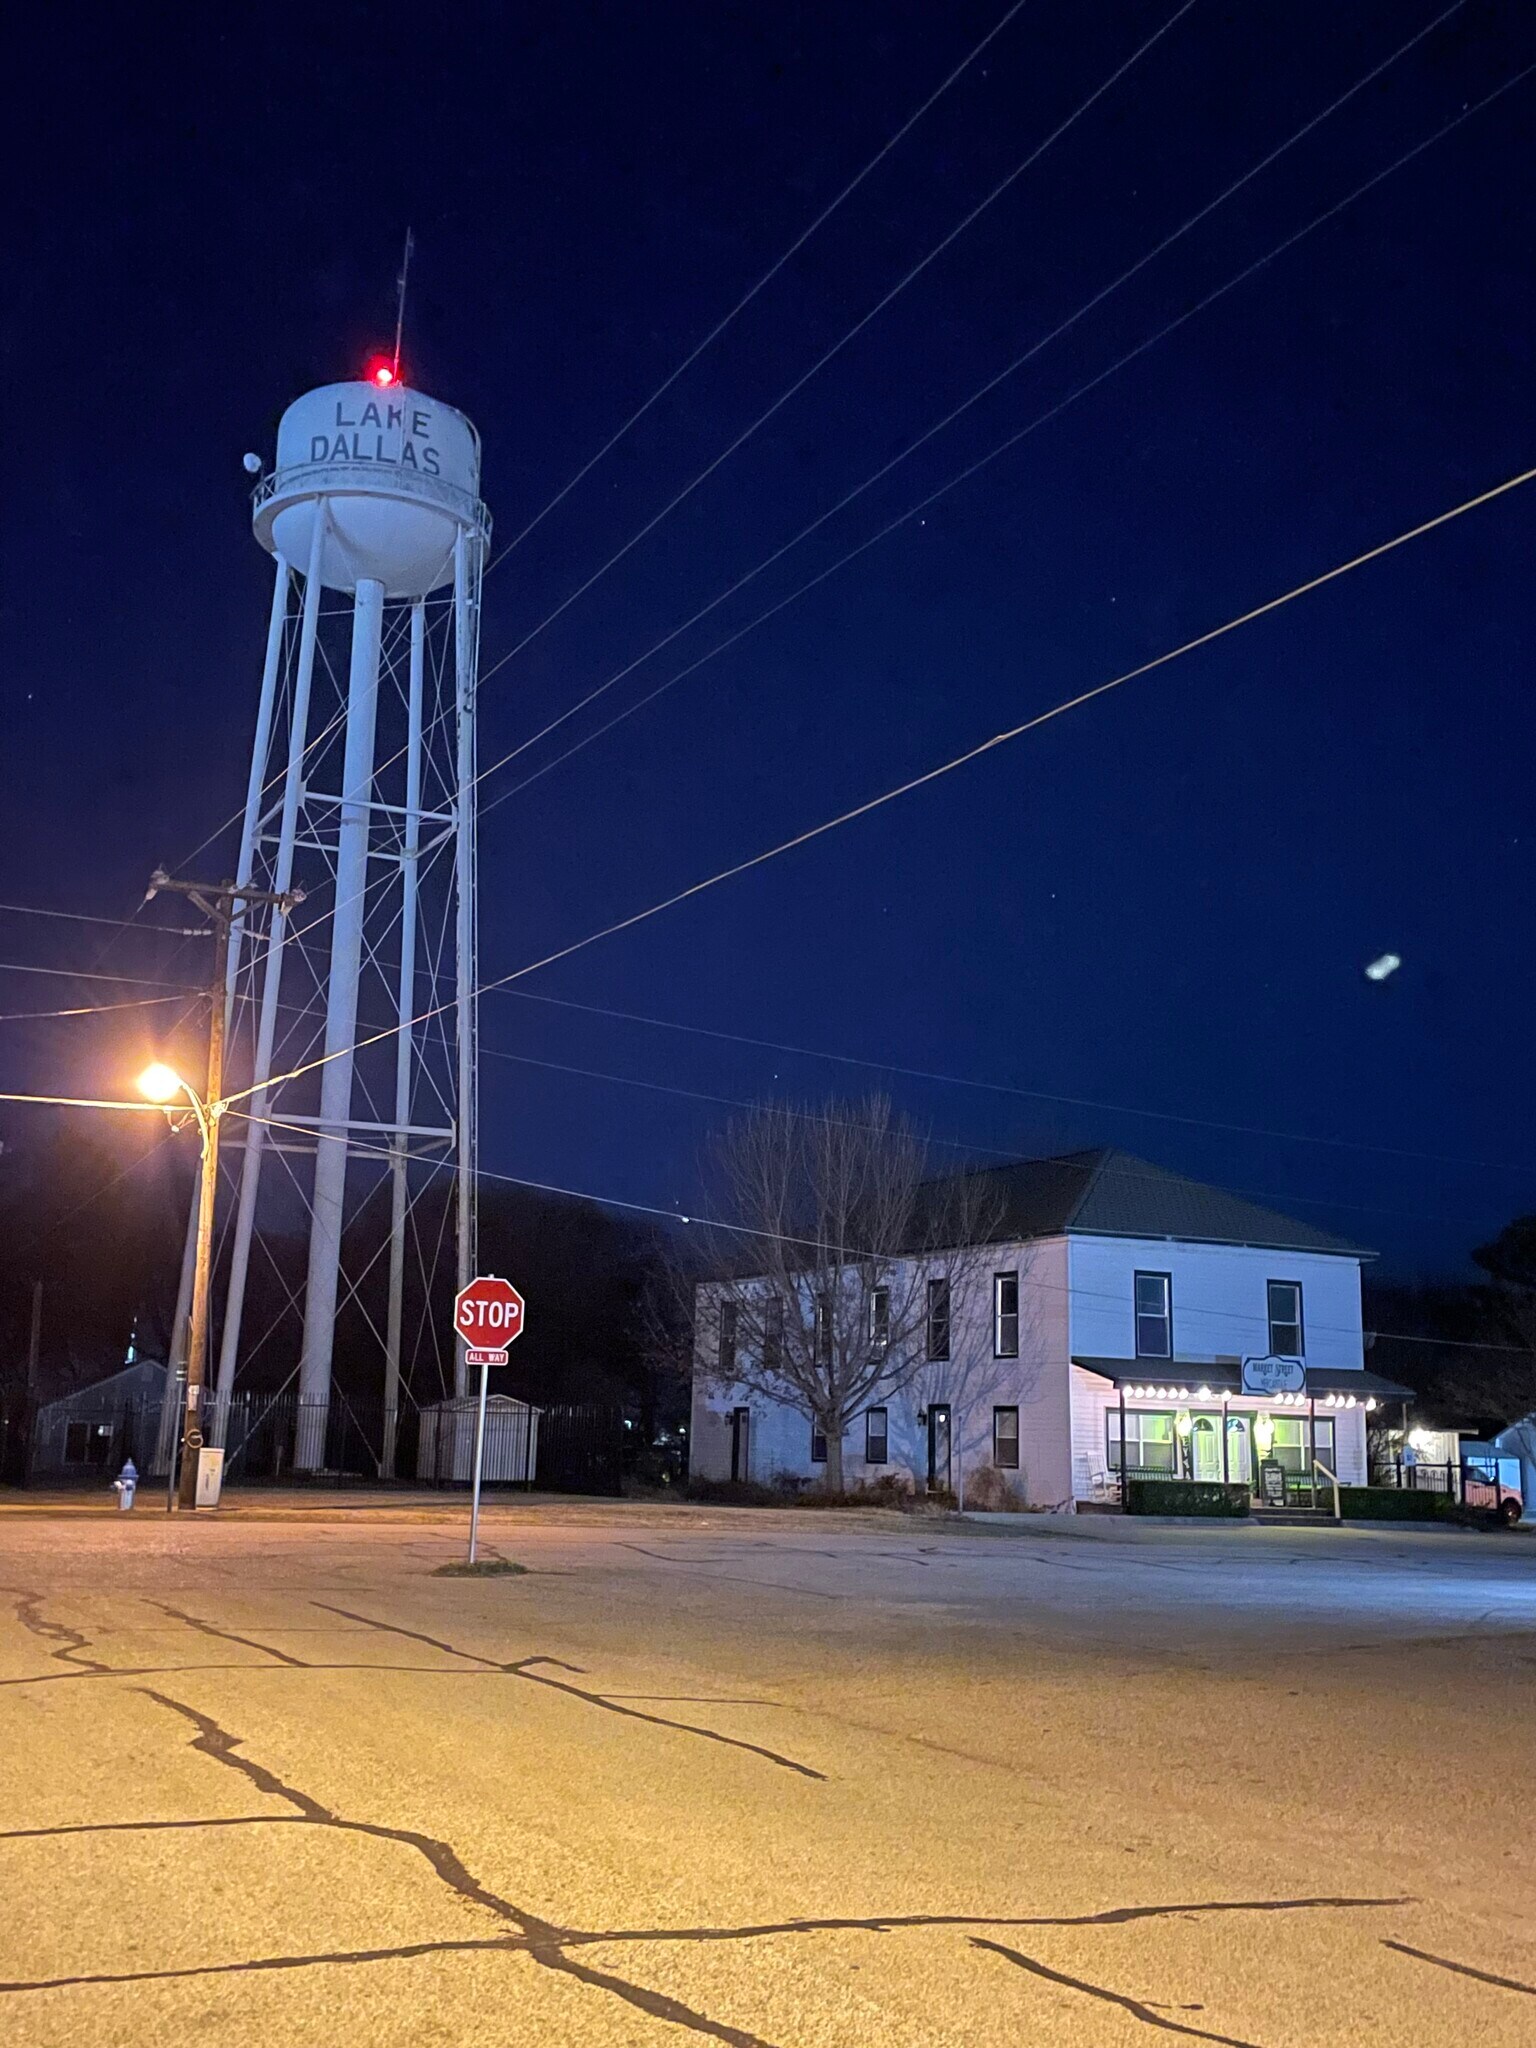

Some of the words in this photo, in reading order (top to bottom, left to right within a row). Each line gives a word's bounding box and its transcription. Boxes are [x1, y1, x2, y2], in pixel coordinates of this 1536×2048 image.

[336, 402, 432, 439] LAKE
[311, 433, 441, 476] DALLAS
[460, 1300, 519, 1328] STOP
[469, 1352, 484, 1362] ALL
[488, 1353, 505, 1362] WAY
[1252, 1362, 1273, 1376] MARKET
[1275, 1363, 1294, 1377] STREET
